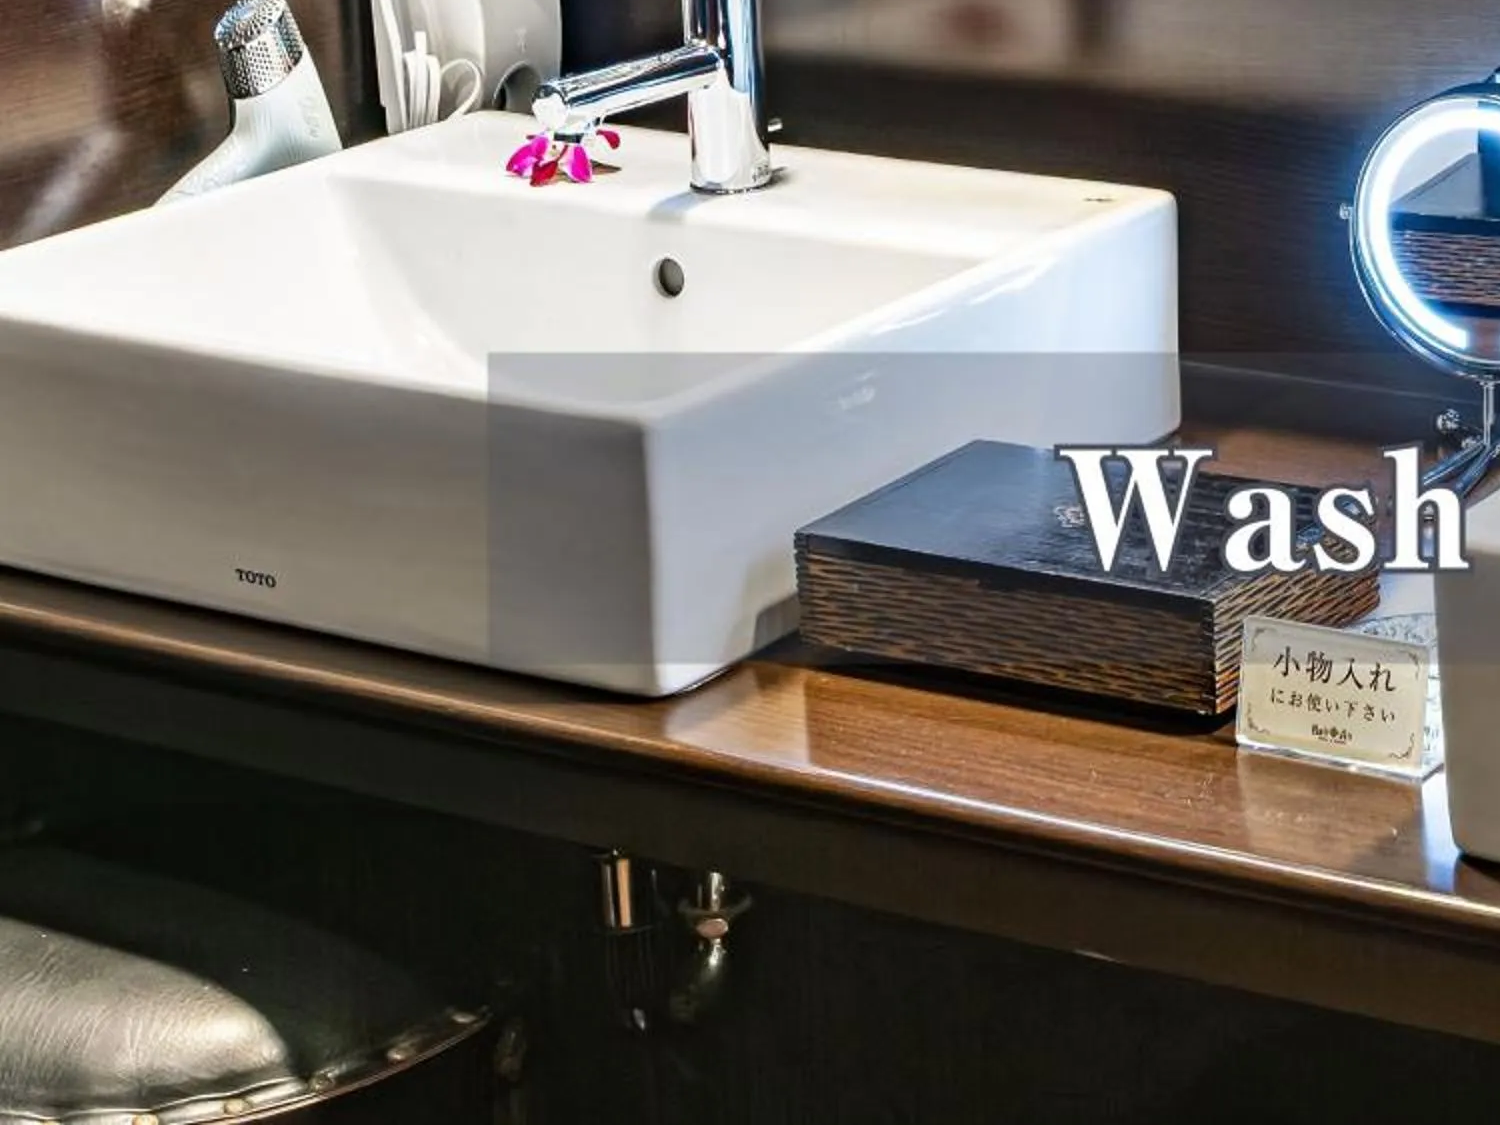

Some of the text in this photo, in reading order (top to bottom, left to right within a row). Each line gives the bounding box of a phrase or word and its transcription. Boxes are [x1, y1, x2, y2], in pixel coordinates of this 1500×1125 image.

[235, 568, 277, 588] TOTO
[1273, 645, 1397, 693] 小物入れ
[1270, 687, 1396, 723] にお使い下さい
